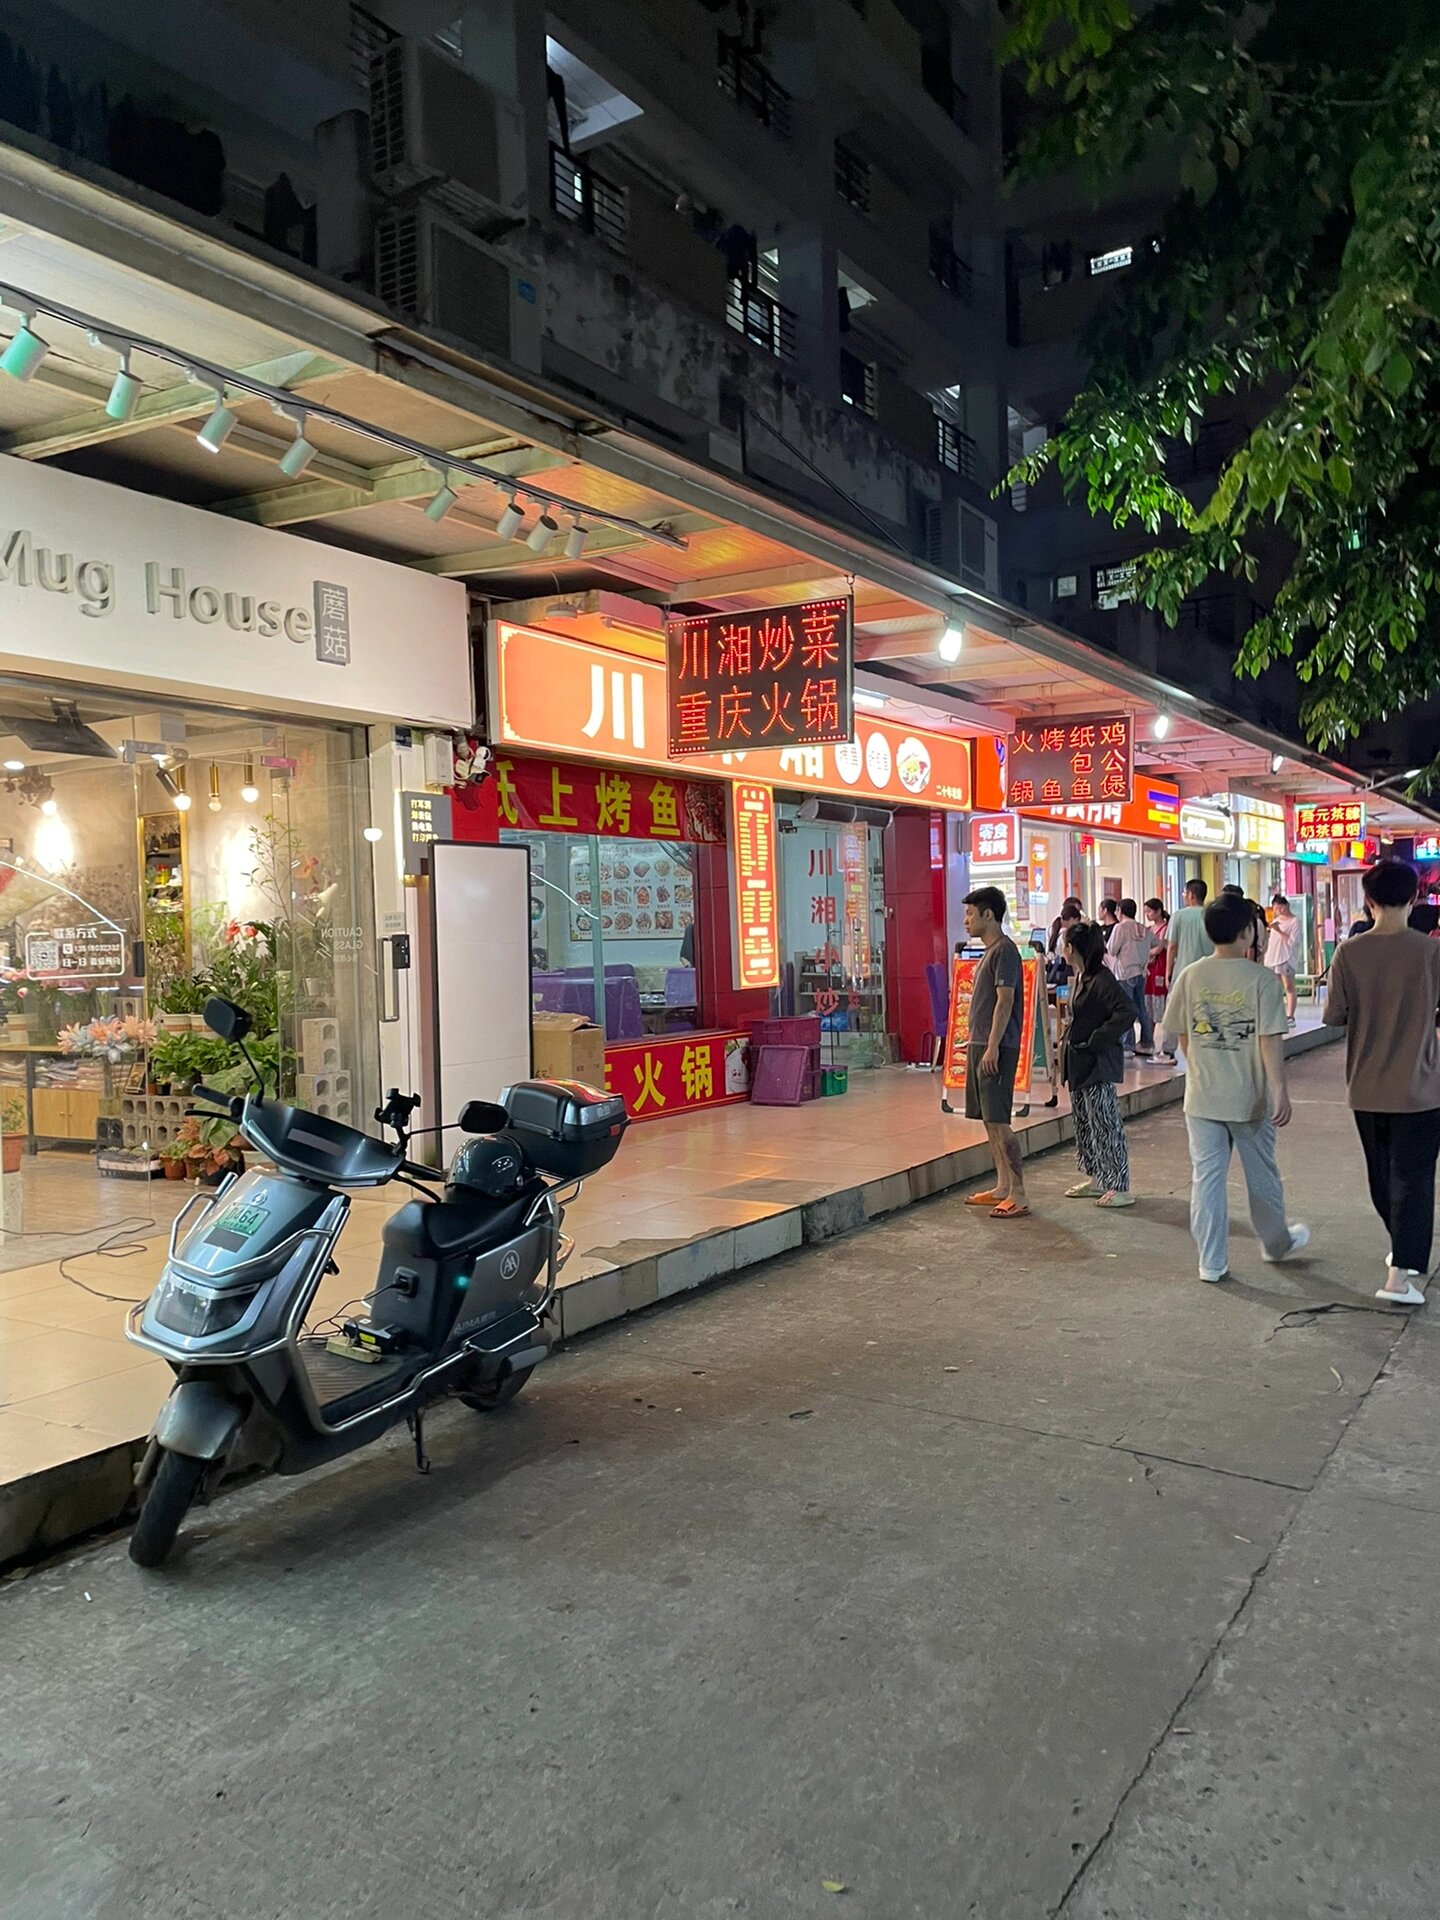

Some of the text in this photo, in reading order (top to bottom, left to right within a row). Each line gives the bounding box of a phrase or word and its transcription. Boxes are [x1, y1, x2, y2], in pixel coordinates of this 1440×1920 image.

[0, 530, 313, 643] Mug House
[320, 587, 348, 659] 蘑菇
[678, 610, 840, 680] 川湘炒菜
[676, 678, 838, 743] 重庆火锅
[979, 823, 1008, 840] 零食
[1300, 822, 1360, 839] 奶茶香烟
[808, 848, 840, 1016] 川湘小炒
[603, 1045, 712, 1112] 火锅
